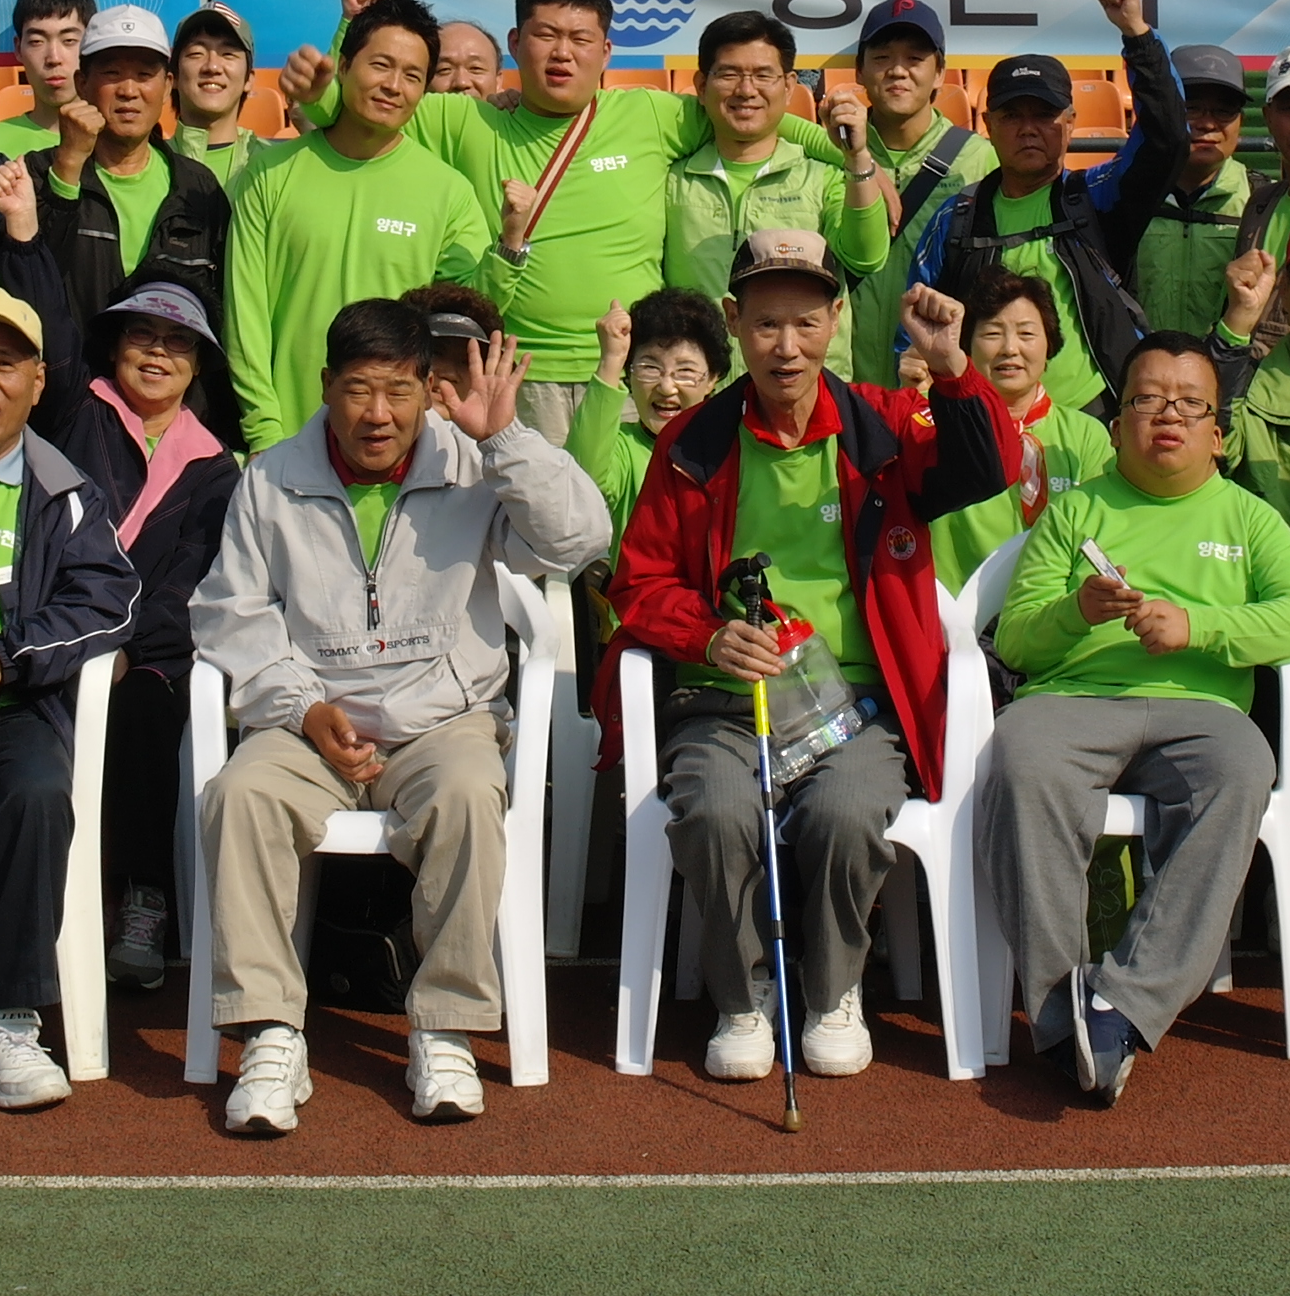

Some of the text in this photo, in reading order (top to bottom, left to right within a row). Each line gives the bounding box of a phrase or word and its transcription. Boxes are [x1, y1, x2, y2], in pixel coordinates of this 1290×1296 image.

[590, 155, 628, 172] 양천구
[376, 218, 417, 237] 양천구
[1198, 541, 1243, 562] 양천구
[386, 635, 429, 649] SPORTS
[317, 646, 359, 657] TOMMY
